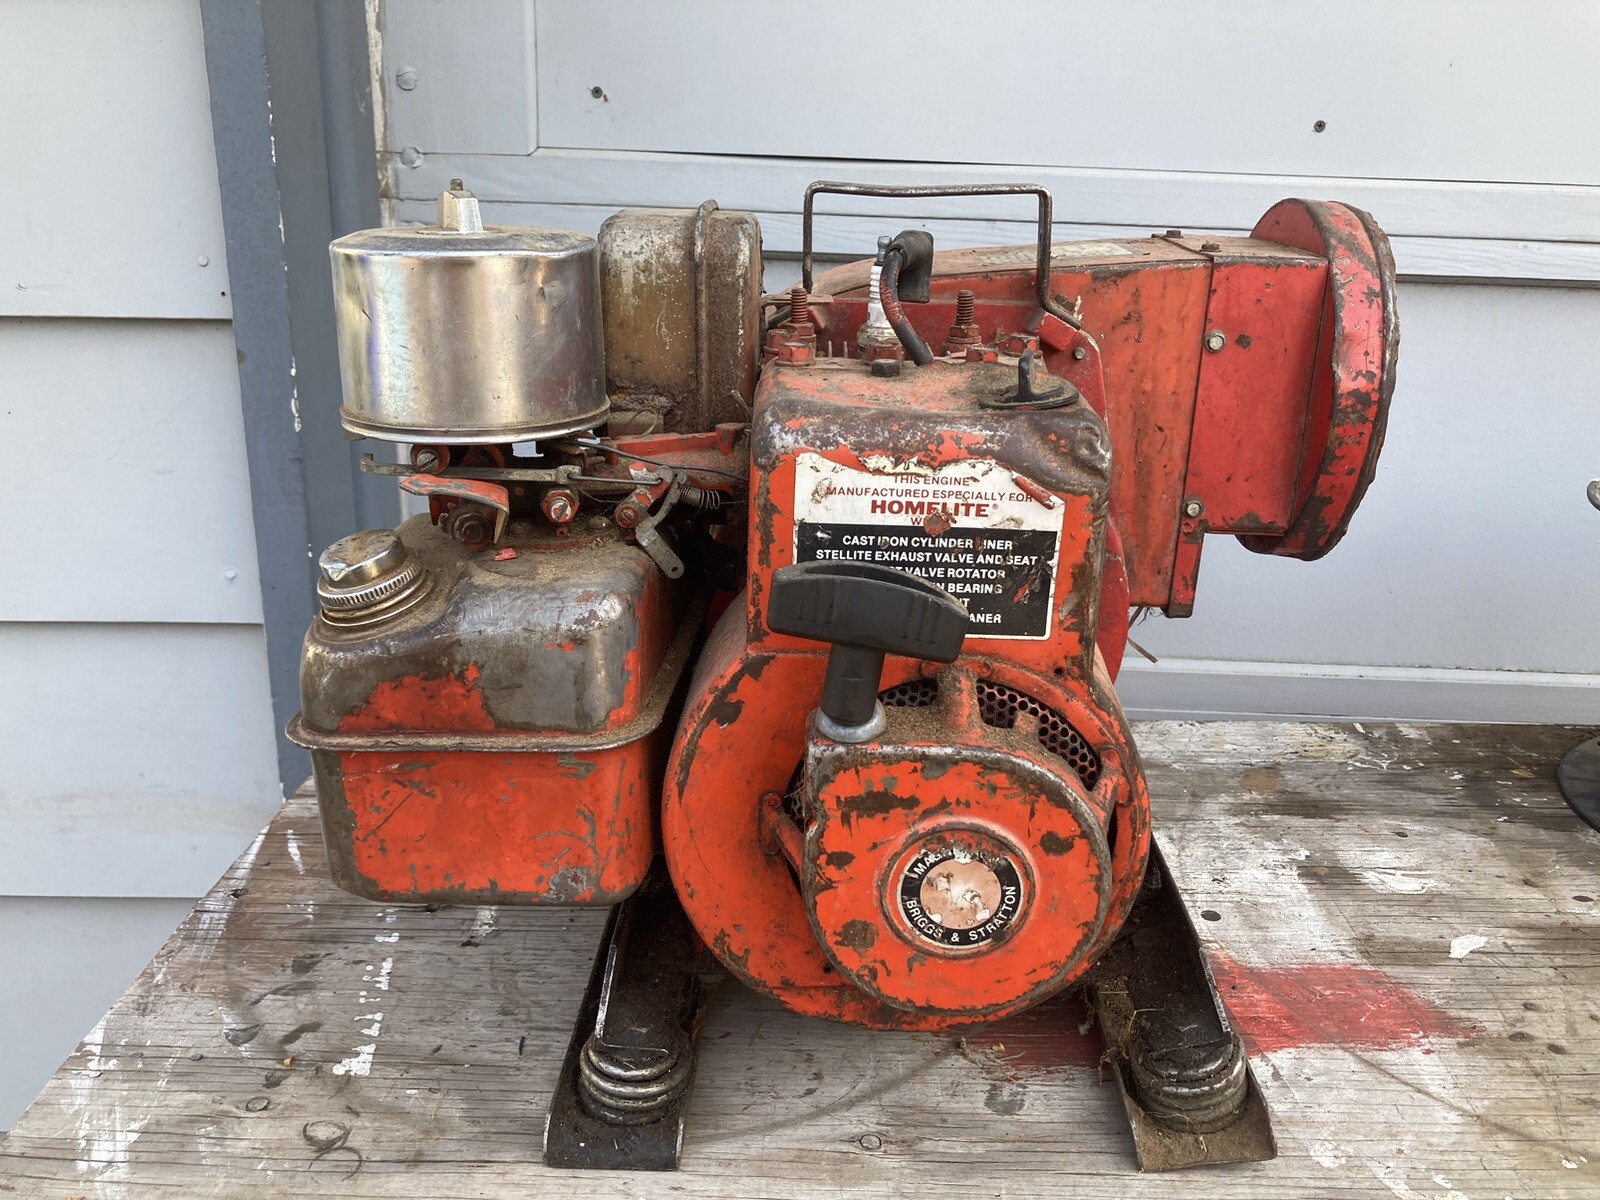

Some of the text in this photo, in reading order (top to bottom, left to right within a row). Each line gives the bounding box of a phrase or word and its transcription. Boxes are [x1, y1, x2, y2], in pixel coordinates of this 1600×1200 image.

[894, 475, 970, 486] THIS ENGINE
[826, 486, 1033, 503] MANUFACTURED ESPECIALLY FOR
[842, 535, 875, 546] CAST
[911, 536, 974, 549] CYLINDER
[976, 537, 1013, 551] INER
[816, 549, 1039, 566] STELLITE EXHAUST VALVE AND SEAT
[947, 569, 1006, 579] ROTATOR
[948, 583, 1003, 594] BEARING
[906, 886, 1017, 942] BRIGGS & STRATTON
